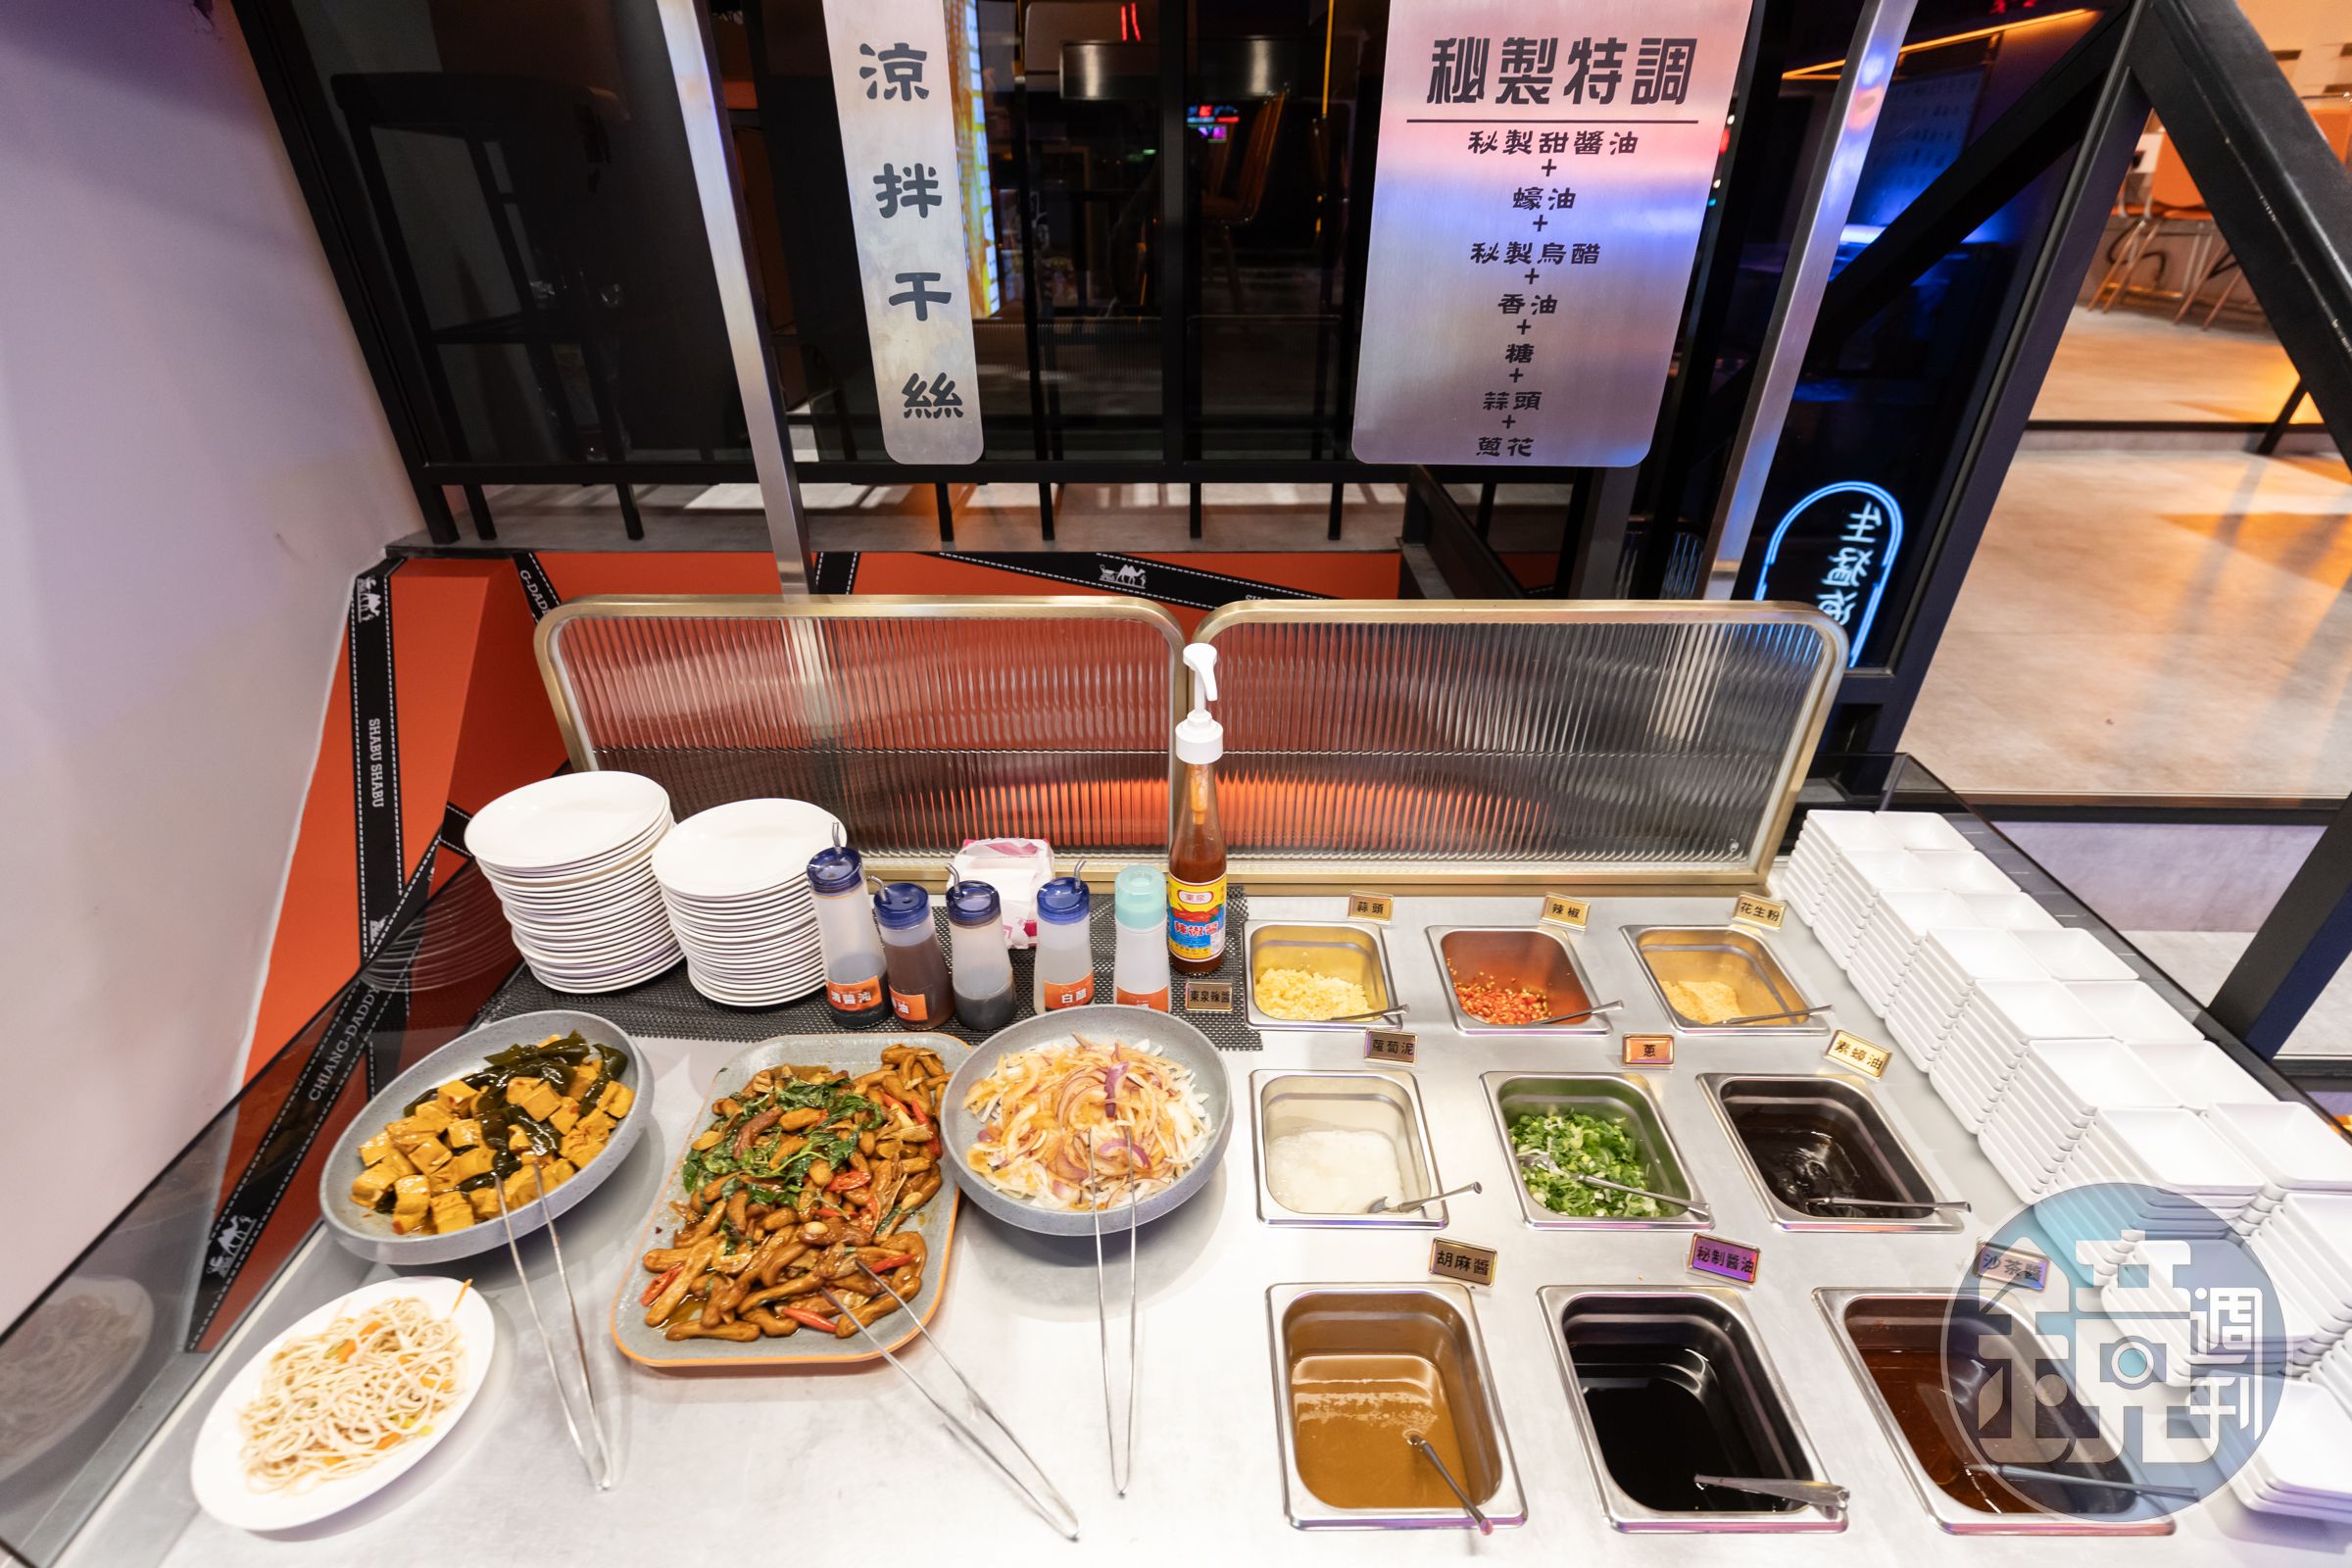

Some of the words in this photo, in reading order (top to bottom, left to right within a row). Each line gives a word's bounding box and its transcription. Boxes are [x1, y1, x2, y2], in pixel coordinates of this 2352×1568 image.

[1426, 37, 1698, 105] 秘製特調
[1467, 130, 1639, 156] 秘製甜醬油
[1512, 186, 1577, 210] 蠔油
[858, 42, 964, 419] 涼拌干絲
[1470, 241, 1600, 266] 秘製烏醋
[1497, 294, 1557, 316] 香油
[1505, 343, 1535, 365] 糖
[1482, 391, 1543, 412] 蒜頭
[368, 717, 382, 761] SHABU
[370, 763, 384, 808] SHABU
[1356, 901, 1385, 914] 蒜頭
[1551, 903, 1581, 919] 辣椒
[1740, 902, 1781, 922] 花生粉
[309, 984, 380, 1101] CHIANG-DADDY
[1437, 1250, 1490, 1276] 胡麻醬
